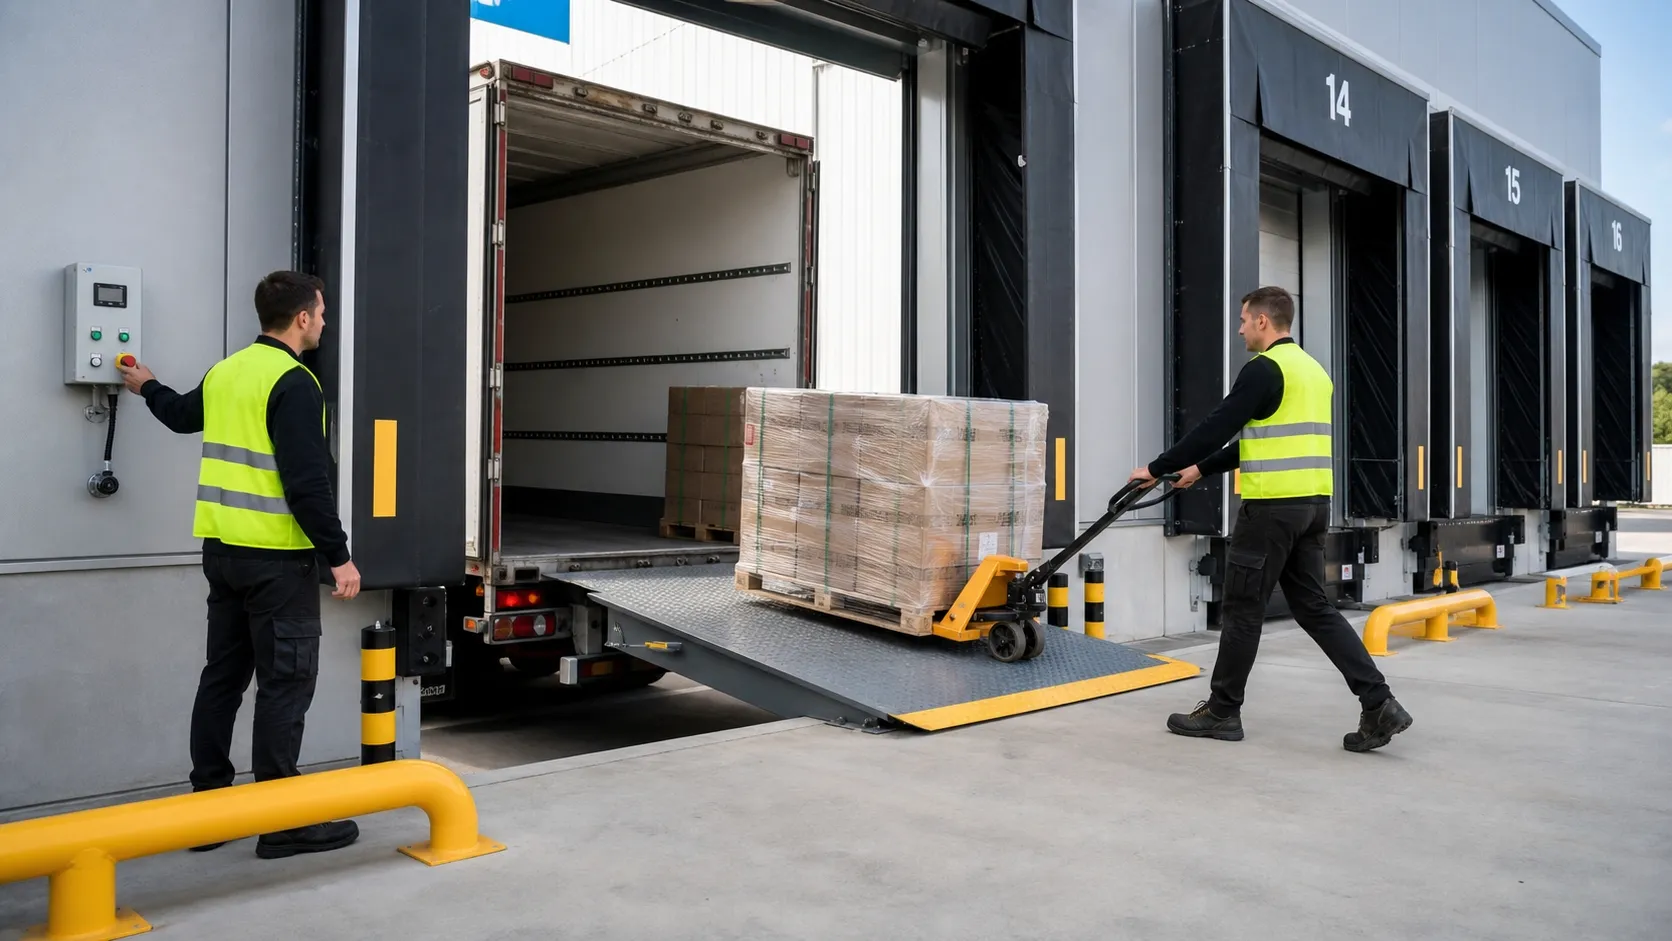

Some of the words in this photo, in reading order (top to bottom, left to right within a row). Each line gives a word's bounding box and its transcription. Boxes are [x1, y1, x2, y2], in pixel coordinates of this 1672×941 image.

[1325, 73, 1351, 127] 14
[1505, 165, 1521, 205] 15
[1611, 219, 1622, 252] 16
